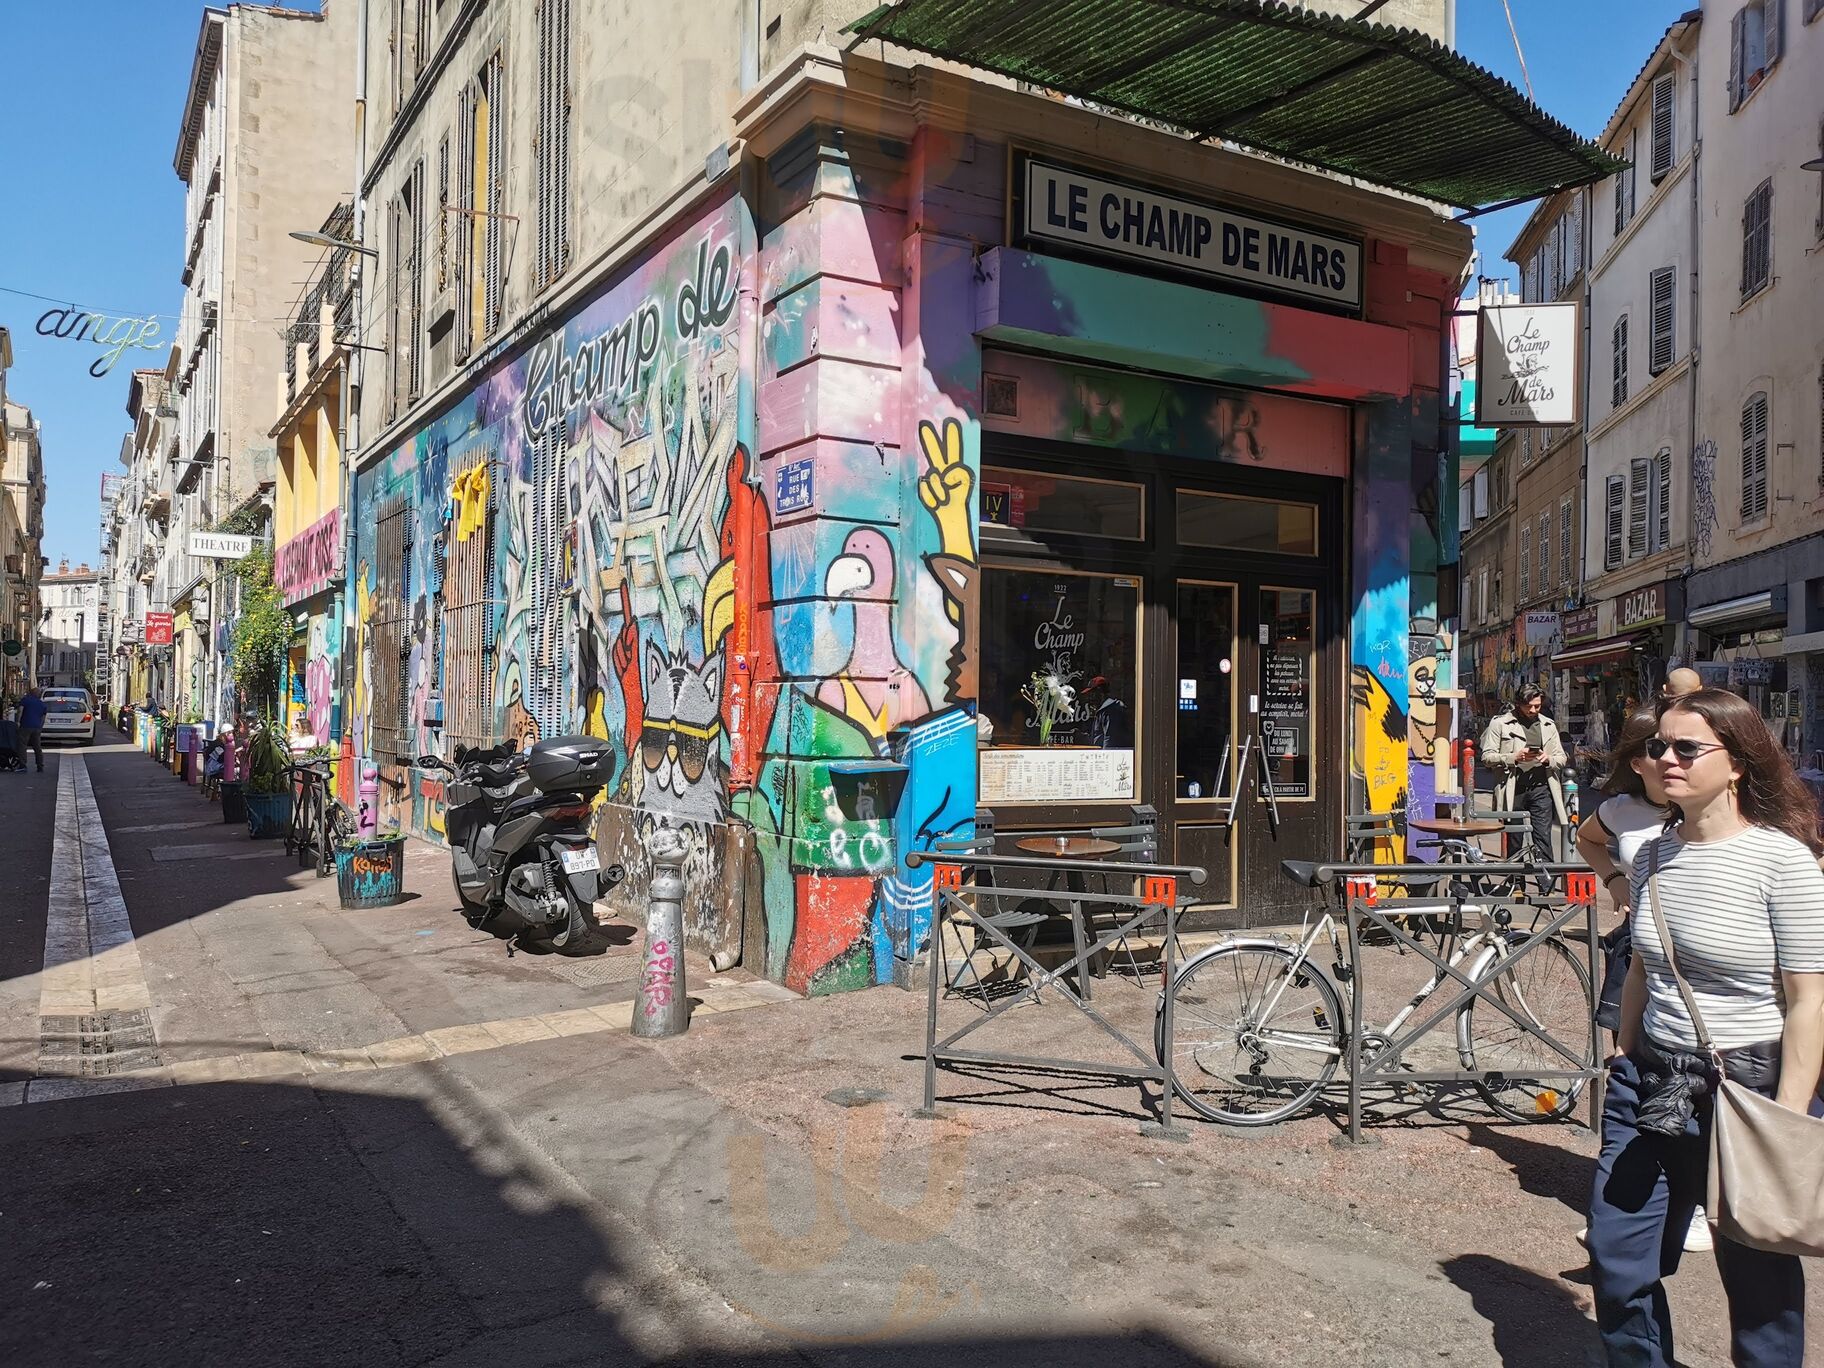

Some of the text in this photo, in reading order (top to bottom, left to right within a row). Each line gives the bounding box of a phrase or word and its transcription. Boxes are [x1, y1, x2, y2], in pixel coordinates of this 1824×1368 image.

[1047, 178, 1346, 292] LE CHAMP DE MARS
[523, 236, 738, 444] Champ de
[1519, 317, 1541, 340] Le
[1506, 335, 1550, 356] Champ
[1497, 379, 1555, 406] Mars
[1528, 376, 1543, 389] de
[788, 473, 800, 484] RUE
[788, 484, 800, 495] DES
[192, 537, 250, 553] THEATRE
[1049, 596, 1074, 630] Le
[1624, 589, 1657, 626] BAZAR
[1527, 615, 1557, 624] BAZAR
[1034, 622, 1085, 655] Champ
